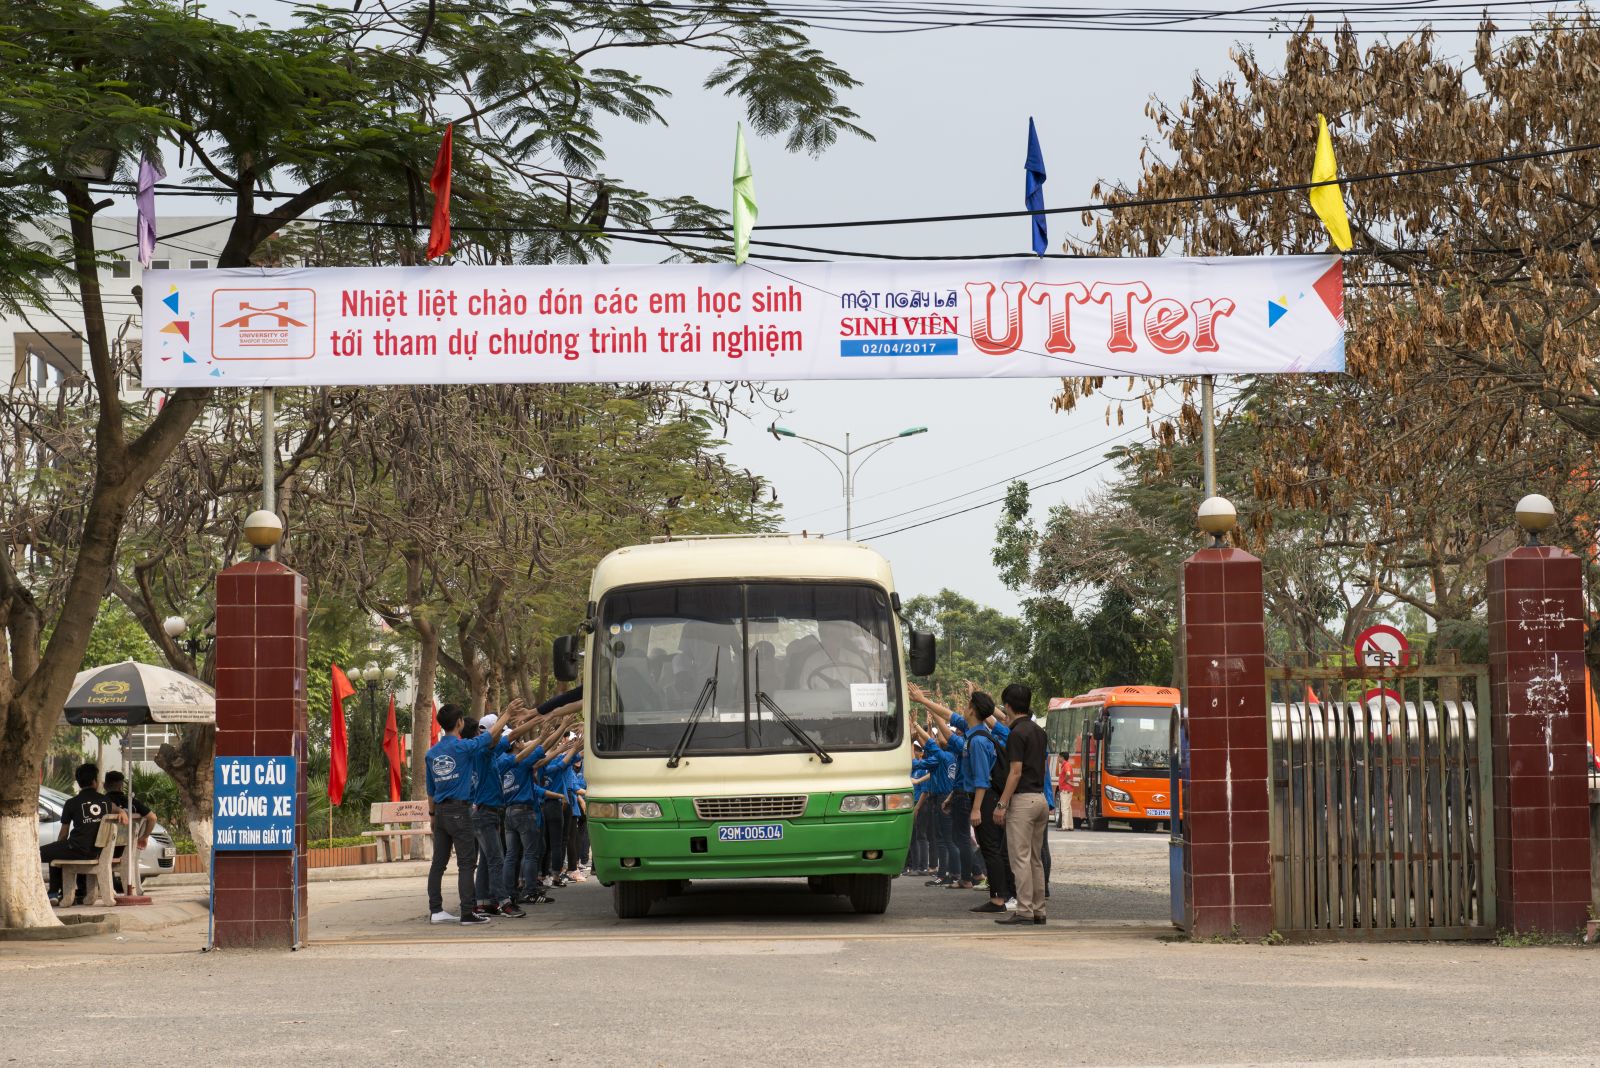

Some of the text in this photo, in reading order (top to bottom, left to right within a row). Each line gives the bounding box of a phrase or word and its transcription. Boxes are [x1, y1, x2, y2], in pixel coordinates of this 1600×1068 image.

[341, 285, 802, 322] Nhiệt liệt chào đón các em học sinh
[839, 313, 959, 337] SINH VIÊN
[964, 280, 1237, 355] UTTer
[330, 322, 803, 360] tới tham dự chương trình trải nghiệm
[862, 343, 937, 355] 02/04/2017
[87, 695, 128, 704] Legend
[221, 758, 286, 785] YÊU CẦU
[217, 789, 292, 817] XUỐNG XE
[217, 823, 292, 844] XUẤT TRÌNH GIẤY TỜ
[720, 826, 781, 840] 29M-005.04
